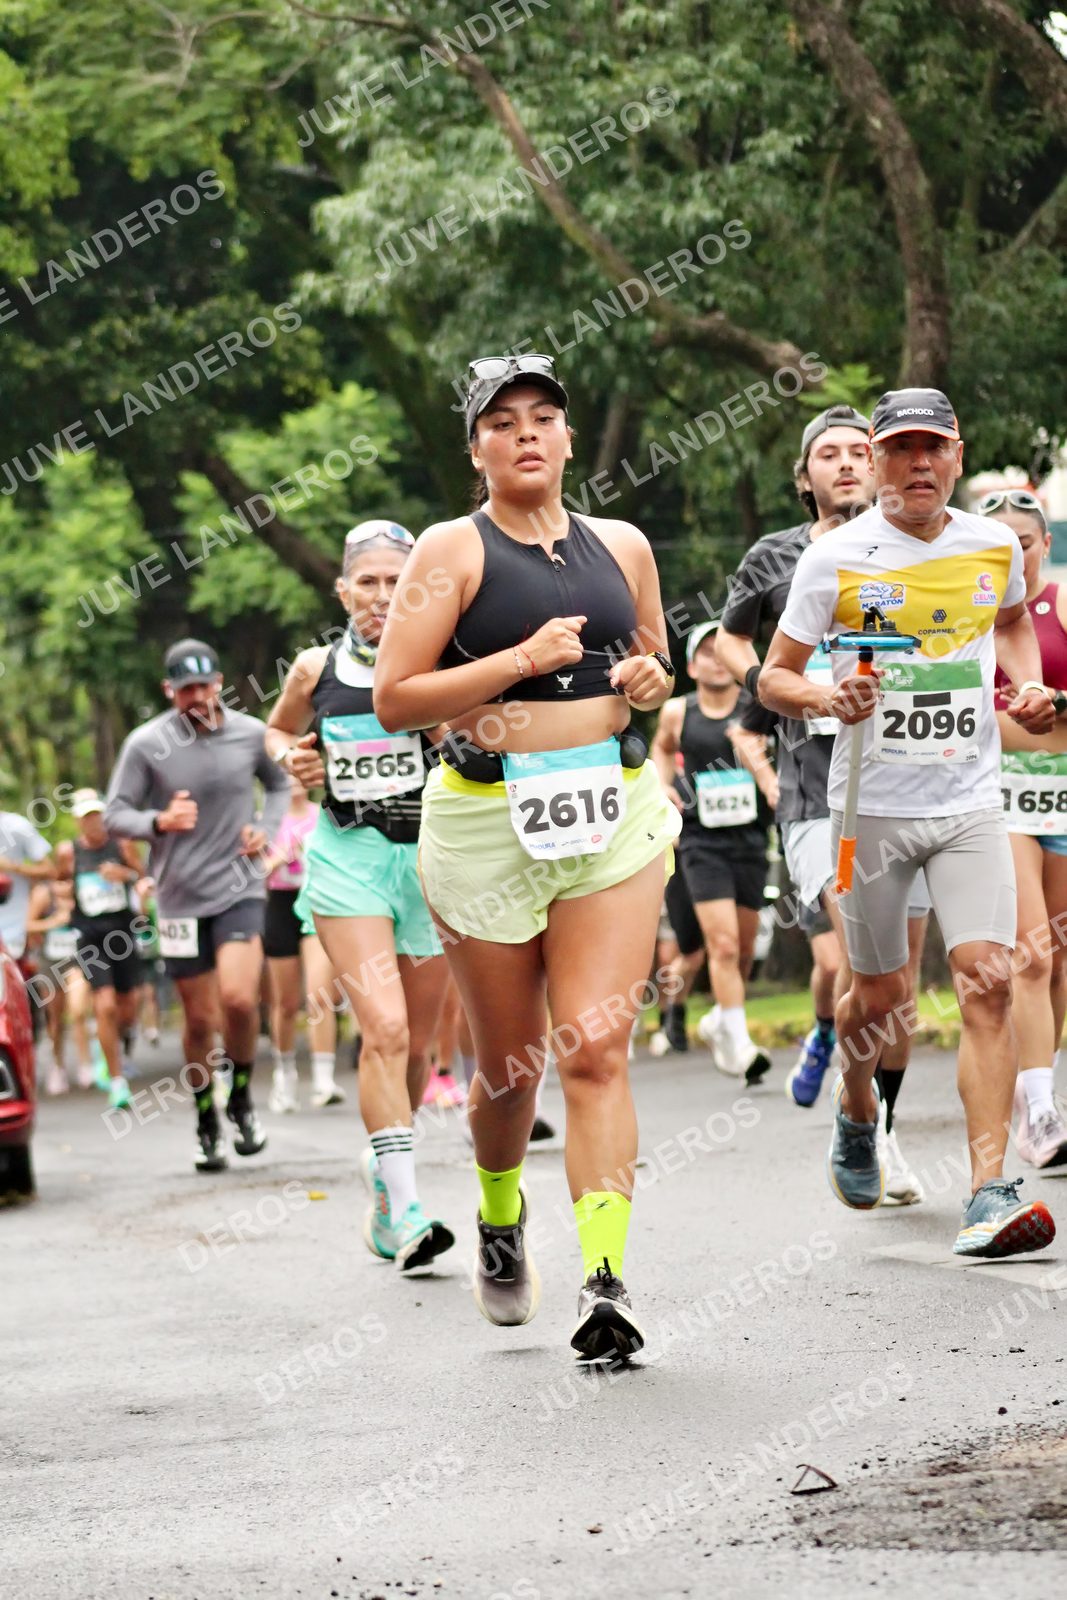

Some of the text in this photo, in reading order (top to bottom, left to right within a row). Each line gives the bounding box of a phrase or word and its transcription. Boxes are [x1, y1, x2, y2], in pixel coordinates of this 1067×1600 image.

[897, 408, 934, 417] BACHOCO
[883, 707, 975, 740] 2096
[335, 752, 416, 780] 2665
[518, 787, 619, 834] 2616
[1001, 788, 1067, 813] 1658
